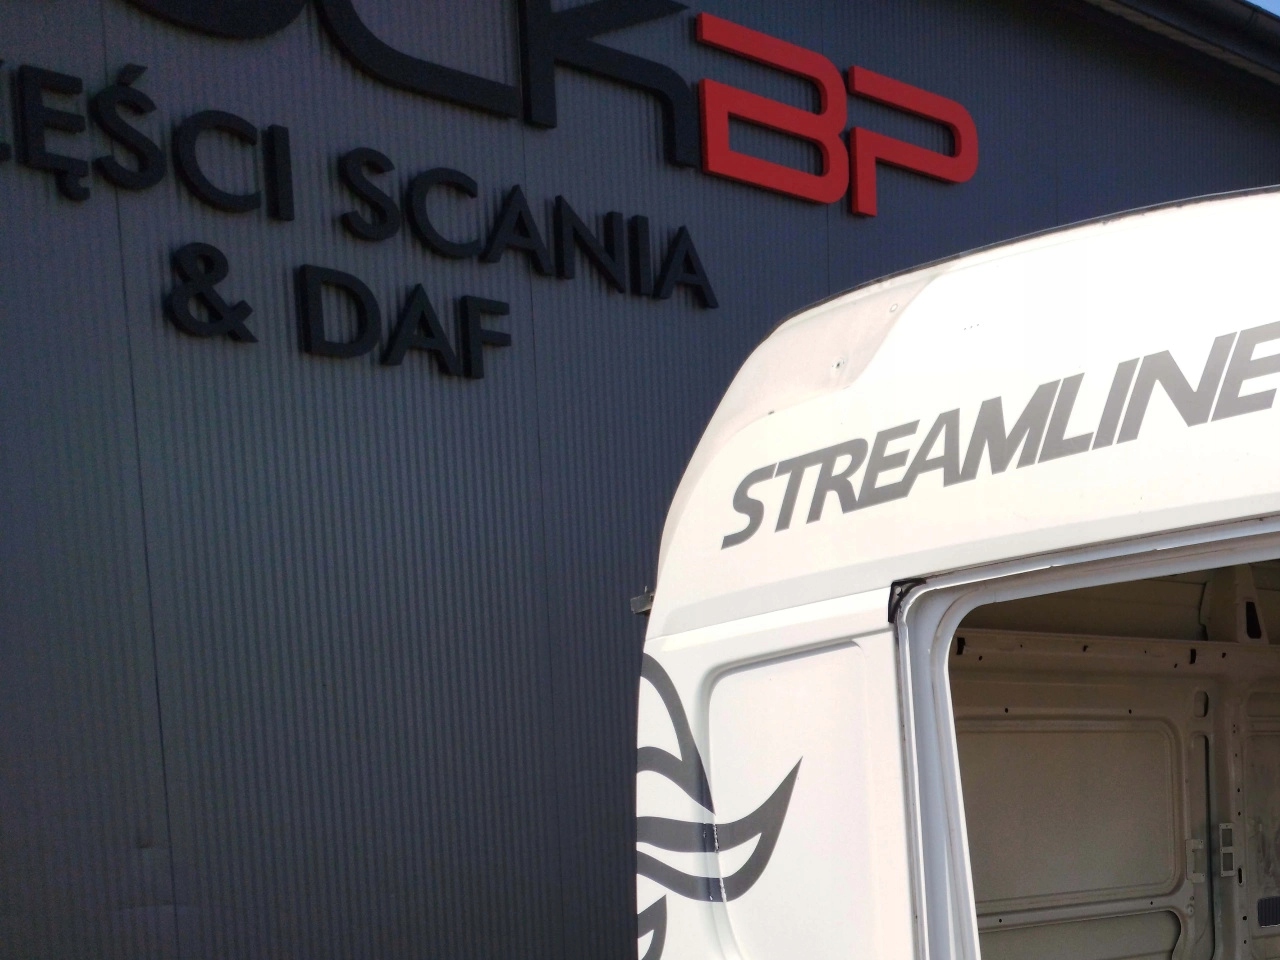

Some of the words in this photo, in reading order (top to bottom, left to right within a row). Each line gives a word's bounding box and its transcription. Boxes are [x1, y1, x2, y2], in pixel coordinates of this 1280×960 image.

[0, 60, 295, 222] ĘŚCI
[338, 147, 719, 309] SCANIA
[164, 242, 259, 343] &
[295, 264, 512, 381] DAF
